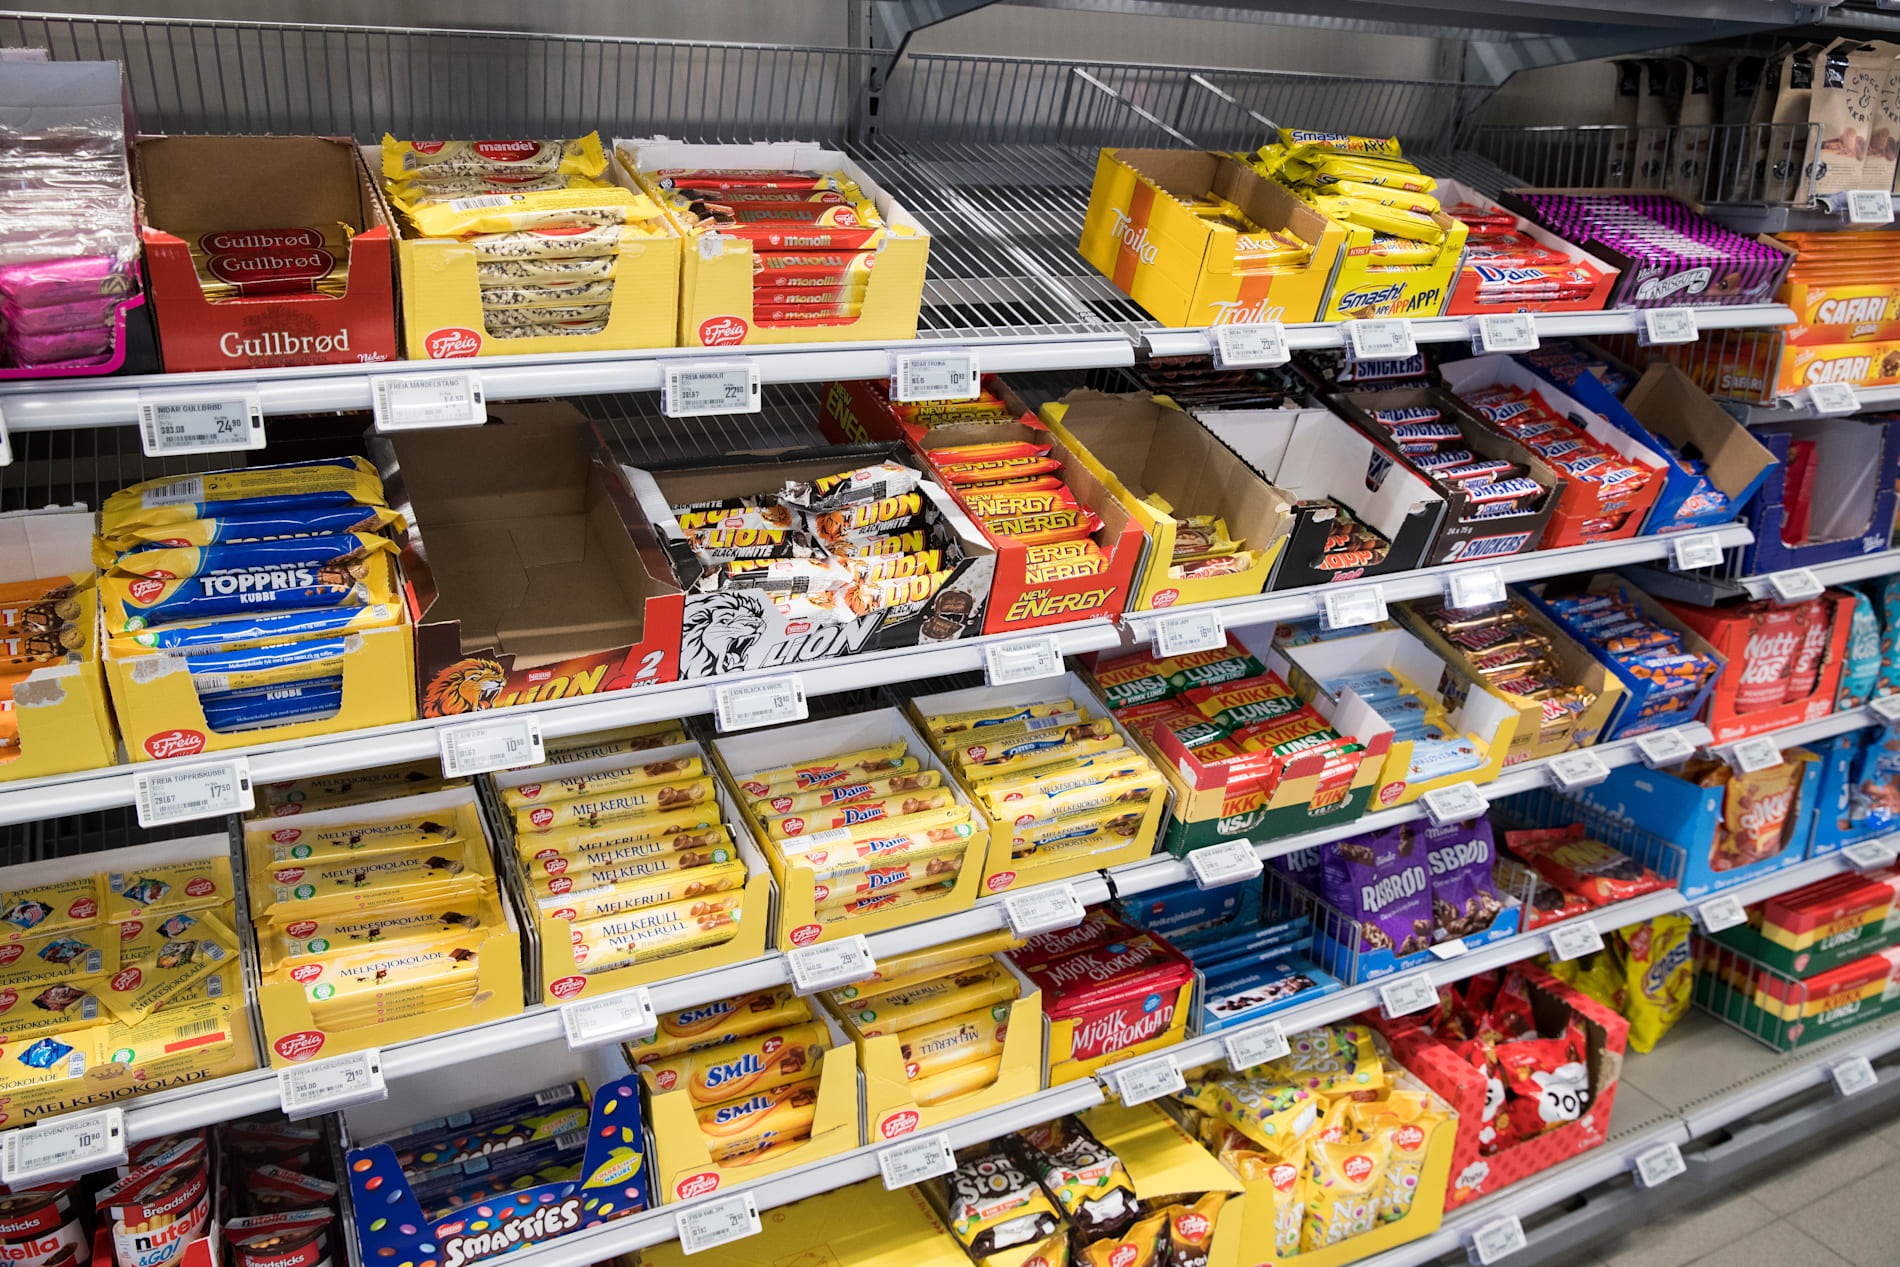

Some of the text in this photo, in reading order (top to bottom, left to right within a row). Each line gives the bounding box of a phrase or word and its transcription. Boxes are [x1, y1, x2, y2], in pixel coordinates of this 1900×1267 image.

[479, 141, 534, 153] mandel
[214, 234, 311, 249] Gullbrød
[784, 234, 832, 247] monolit
[1112, 208, 1159, 265] Troika
[222, 254, 322, 271] Gullbrød
[788, 276, 835, 287] monolit
[1474, 265, 1549, 285] Daim
[786, 293, 832, 303] monolit
[1337, 281, 1408, 311] Smash!
[784, 309, 831, 320] monolit
[1208, 298, 1286, 325] Troika
[1818, 297, 1889, 325] SAFARI
[433, 332, 477, 352] Freia
[705, 320, 744, 342] Freia
[220, 329, 349, 357] Gullbrød
[1357, 356, 1423, 377] SNICKERS
[1805, 357, 1872, 384] SAFARI
[833, 381, 852, 405] NEW
[182, 403, 222, 412] GULLBRØD
[920, 407, 945, 415] NEW
[967, 494, 992, 503] NEW
[989, 510, 1079, 535] ENERGY
[1442, 535, 1525, 562] 2 SNICKERS
[133, 577, 166, 598] Freia
[200, 568, 314, 596] TOPPRIS
[240, 591, 276, 604] KUBBE
[1004, 587, 1117, 622] ENERGY
[1019, 588, 1051, 601] NEW
[635, 650, 665, 680] 2
[1173, 643, 1236, 670] KVIKK
[1097, 663, 1158, 687] KVIKK
[1185, 658, 1248, 682] LUNSJ
[267, 688, 302, 700] KUBBE
[1106, 675, 1168, 700] LUNSJ
[1215, 683, 1281, 709] KVIKK
[1227, 696, 1292, 721] LUNSJ
[1253, 717, 1318, 746] KVIKK
[151, 732, 200, 754] Freia
[1010, 743, 1035, 755] OREO
[549, 744, 622, 766] MELKERULL
[152, 769, 226, 785] FREIA TOPPRISKUBBE
[560, 768, 634, 788] MELKERULL
[800, 768, 845, 785] Daim
[833, 784, 870, 801] Daim
[573, 794, 648, 817] MELKERULL
[845, 807, 882, 824] Daim
[317, 823, 414, 841] MELKESJOKOLADE
[587, 842, 664, 864] MELKERULL
[869, 836, 907, 852] Daim
[321, 859, 421, 880] MELKESJOKOLADE
[592, 860, 670, 883] MELKERULL
[869, 871, 905, 888] Daim
[1361, 866, 1427, 912] RISBRØD
[597, 891, 674, 915] MELKERULL
[334, 913, 436, 934] MELKESJOKOLADE
[602, 911, 681, 937] MELKERULL
[1149, 906, 1205, 927] Melkesjokolade
[609, 922, 688, 947] MELKERULL
[792, 926, 822, 941] Freia
[340, 952, 444, 977] MELKESJOKOLADE
[1046, 952, 1103, 986] Mjölk
[1089, 943, 1154, 982] CHOKLAD
[136, 962, 208, 1012] MELKESJOKOLADE
[553, 977, 585, 993] Freia
[886, 982, 946, 1004] MELKERULL
[678, 1002, 735, 1026] SMIL
[1072, 1004, 1175, 1056] Mjölk CHOKLAD
[281, 1036, 323, 1052] Freia
[919, 1030, 980, 1054] MELKERULL
[656, 1073, 677, 1085] Freia
[706, 1053, 765, 1088] SMIL
[23, 1069, 213, 1119] MELKESJOKOLADE
[715, 1094, 775, 1124] SMIL
[541, 1117, 566, 1133] COLORS
[552, 1119, 578, 1134] NATURE
[884, 1117, 917, 1137] Freia
[109, 1163, 157, 1193] nutella
[593, 1156, 638, 1181] COLORS FROM
[603, 1165, 632, 1183] NATURE
[680, 1176, 718, 1196] Freia
[143, 1180, 202, 1218] Breadsticks
[135, 1200, 209, 1251] nutella
[242, 1212, 288, 1227] nutella
[444, 1199, 580, 1267] SMARTIES
[139, 1237, 181, 1267] &GO!
